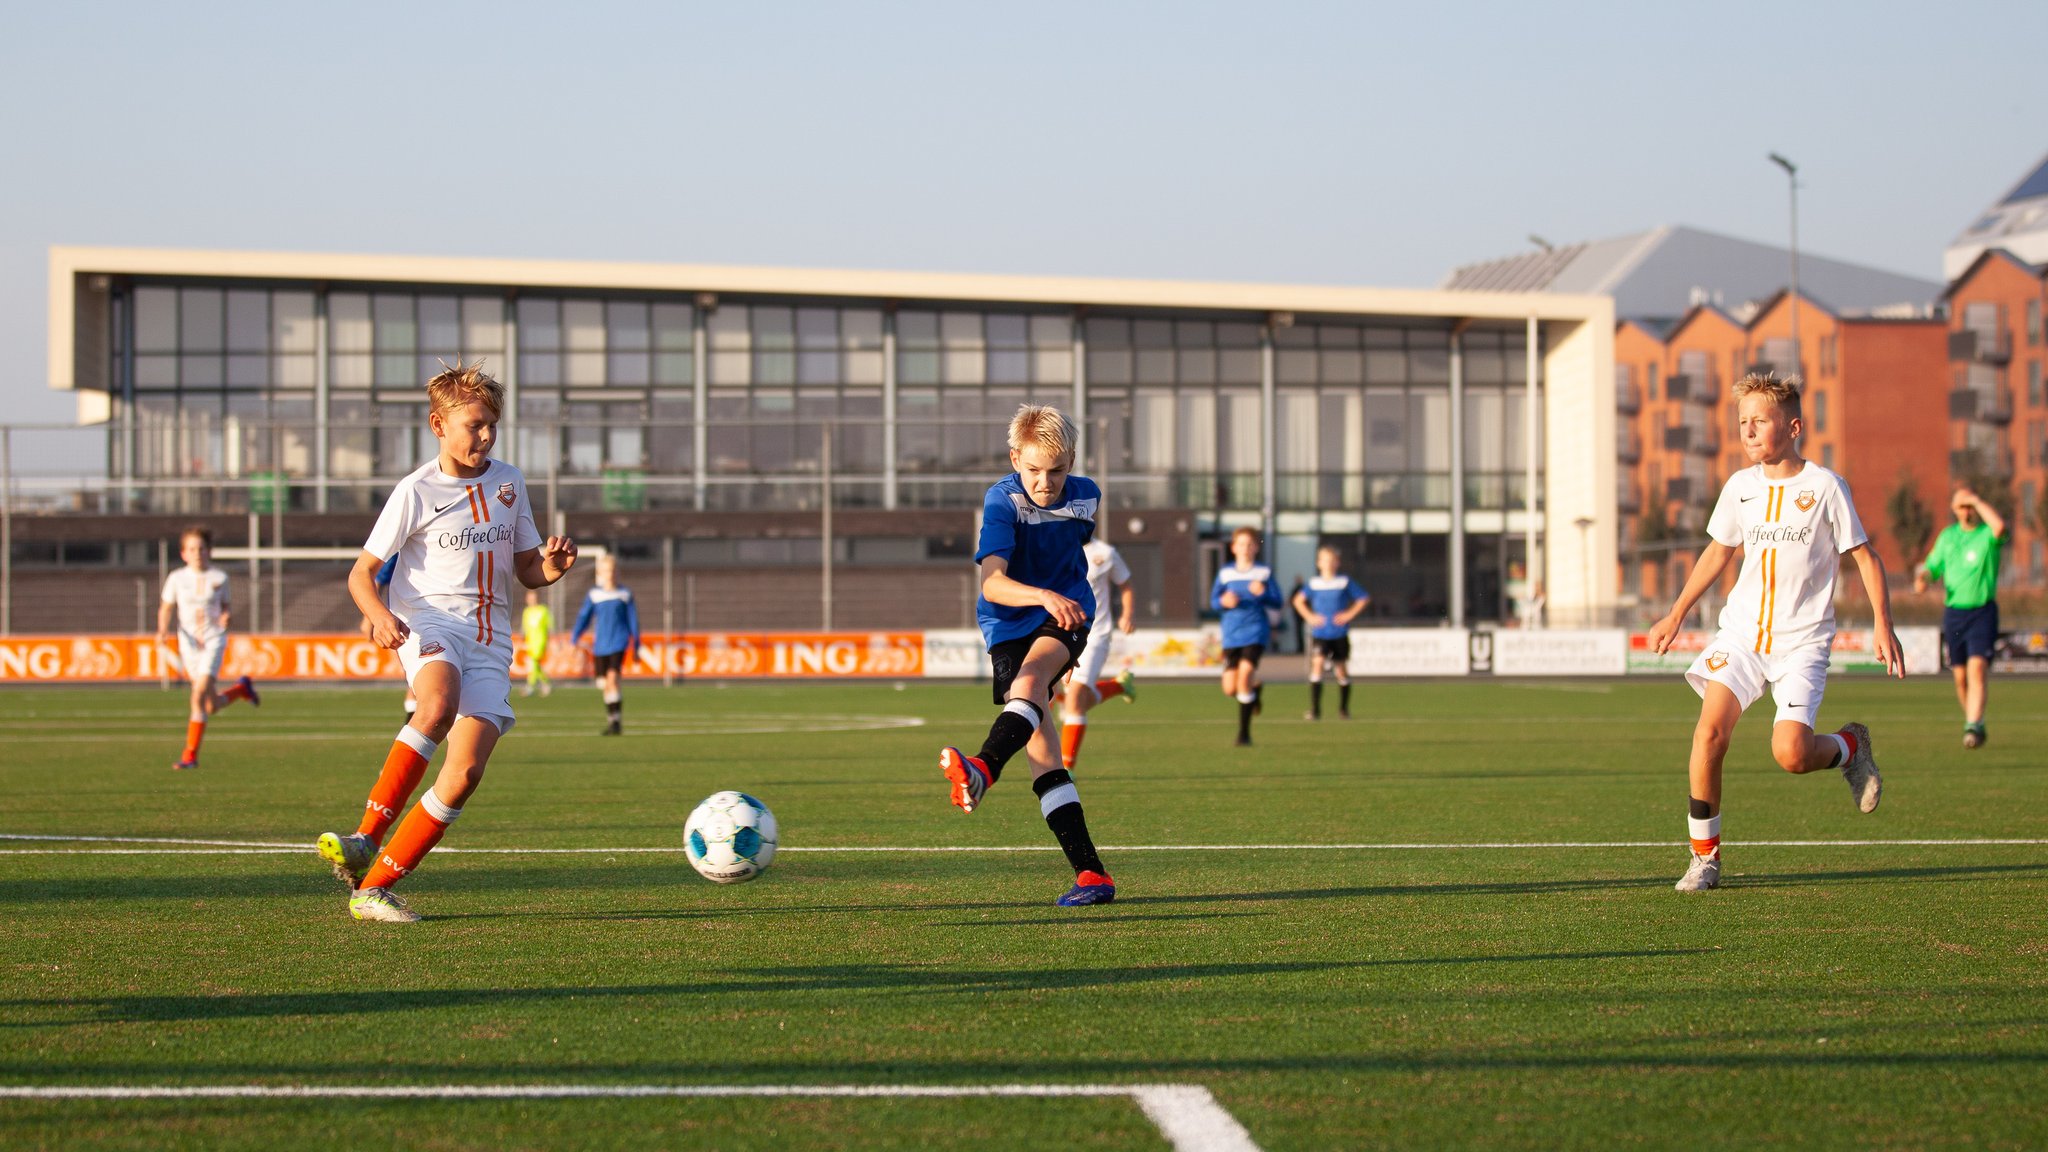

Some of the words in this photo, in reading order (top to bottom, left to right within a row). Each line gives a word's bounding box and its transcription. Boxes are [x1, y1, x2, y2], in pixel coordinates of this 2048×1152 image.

[1747, 525, 1810, 545] offeeClick
[0, 644, 61, 678] NG
[296, 644, 379, 676] ING
[630, 642, 697, 674] NG
[771, 641, 857, 674] ING
[366, 799, 395, 820] BVC
[382, 855, 411, 876] BVC
